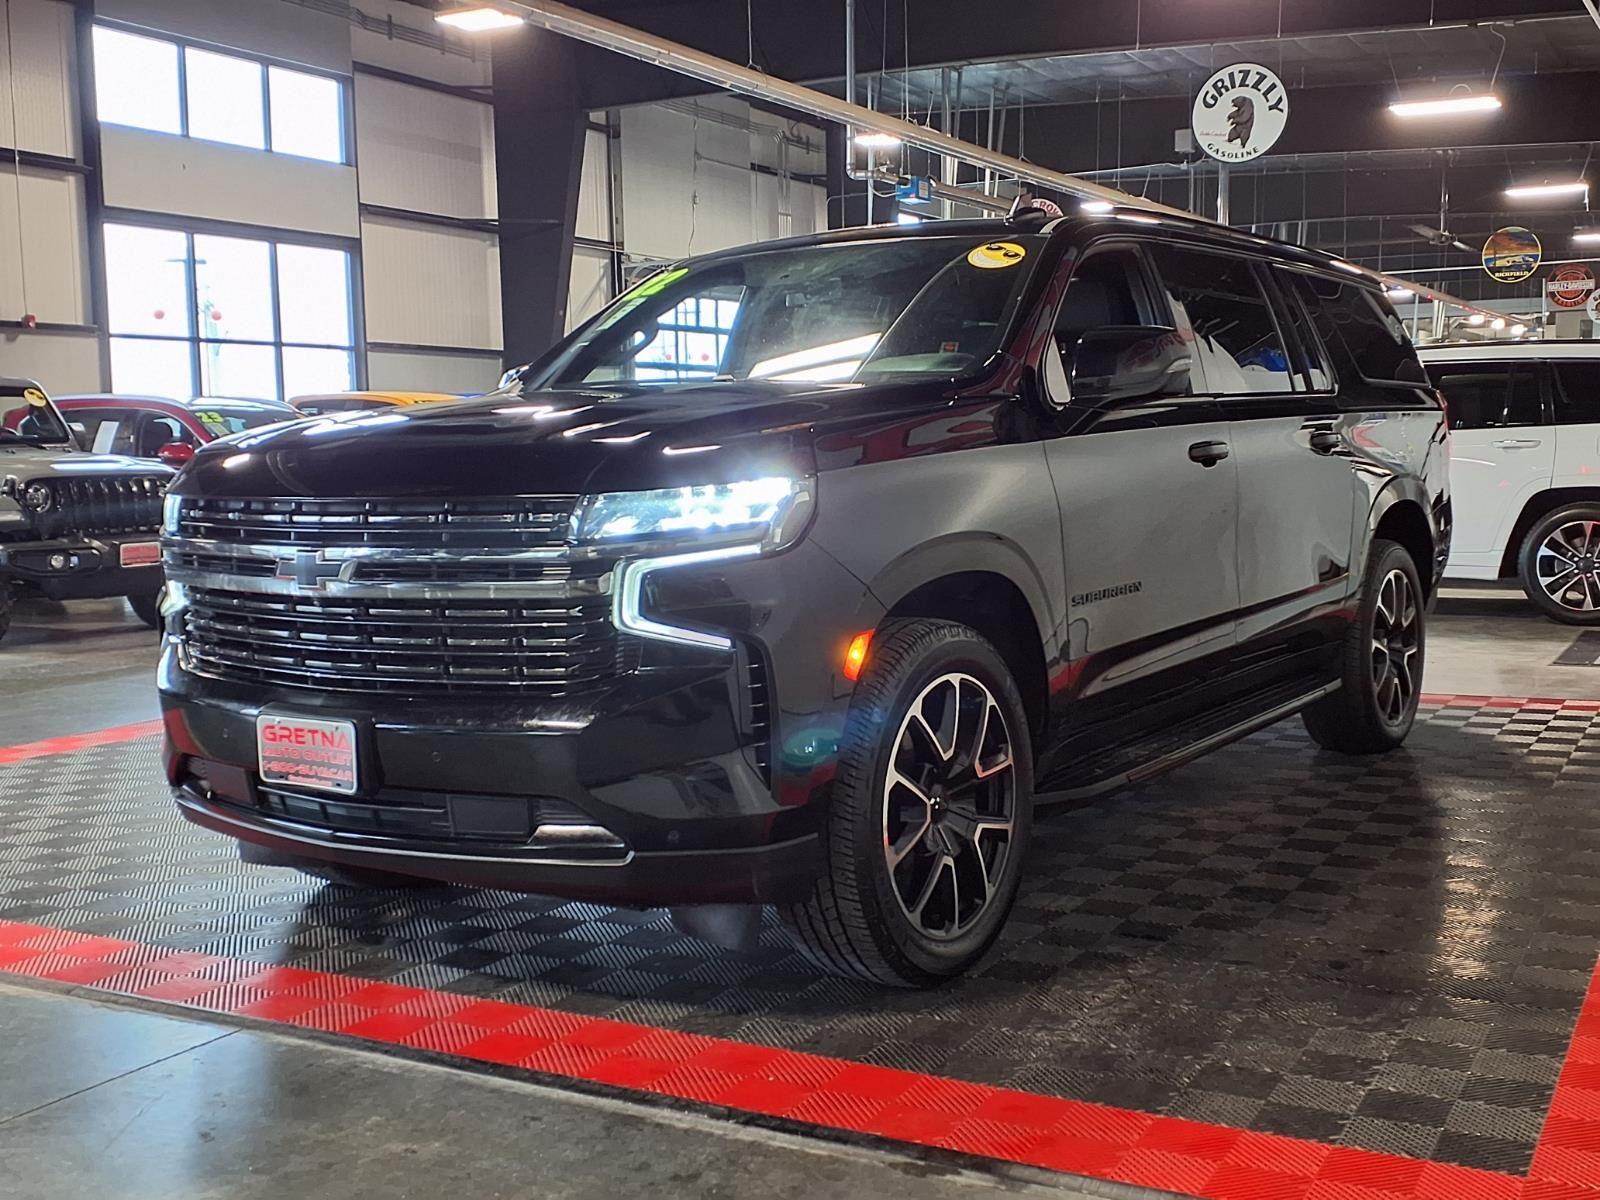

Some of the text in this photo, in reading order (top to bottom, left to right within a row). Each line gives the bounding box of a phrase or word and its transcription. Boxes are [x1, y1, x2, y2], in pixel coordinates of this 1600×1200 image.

[1202, 69, 1284, 113] GRIZZLY
[1207, 142, 1260, 159] GASOLINE
[1071, 581, 1142, 607] SUBURBAN
[262, 724, 349, 749] GRETNA
